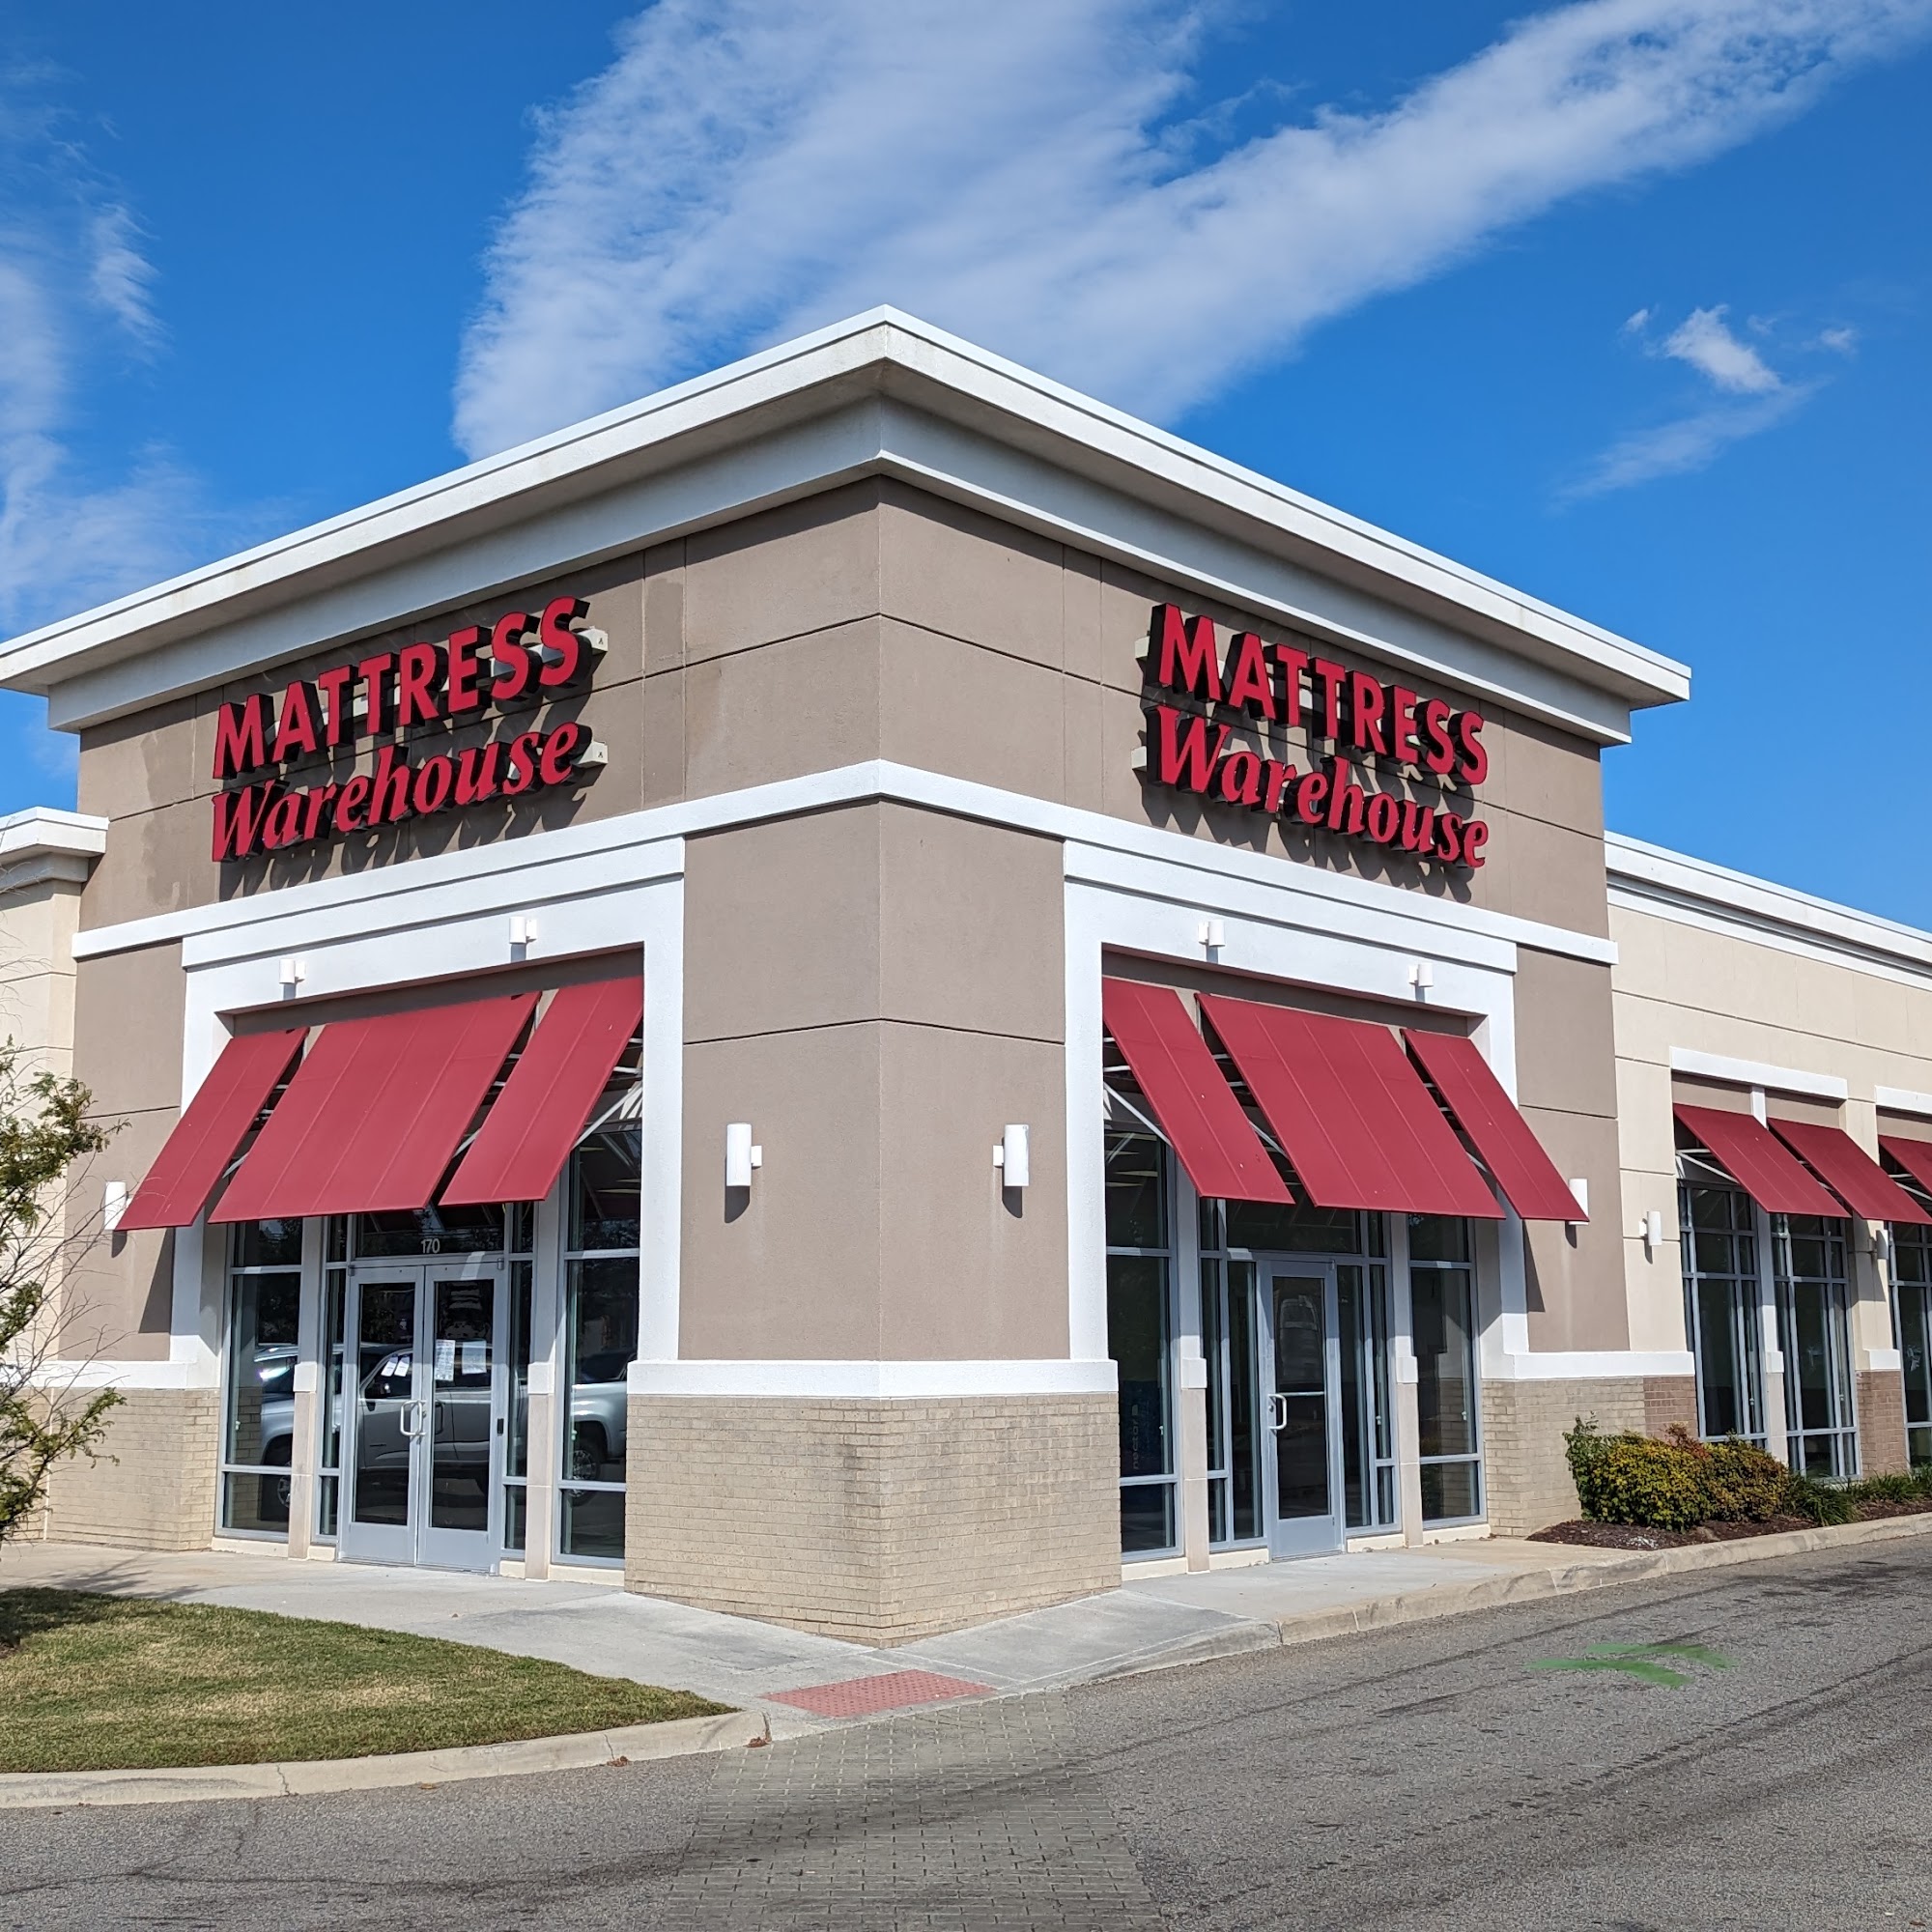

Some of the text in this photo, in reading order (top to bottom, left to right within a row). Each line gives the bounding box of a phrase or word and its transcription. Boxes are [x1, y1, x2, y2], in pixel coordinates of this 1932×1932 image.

[213, 598, 579, 778] MATTRESS
[1158, 604, 1488, 784] MATTRESS
[212, 723, 579, 862] Warehouse
[1157, 705, 1489, 868] Warehouse
[420, 1237, 440, 1254] 170
